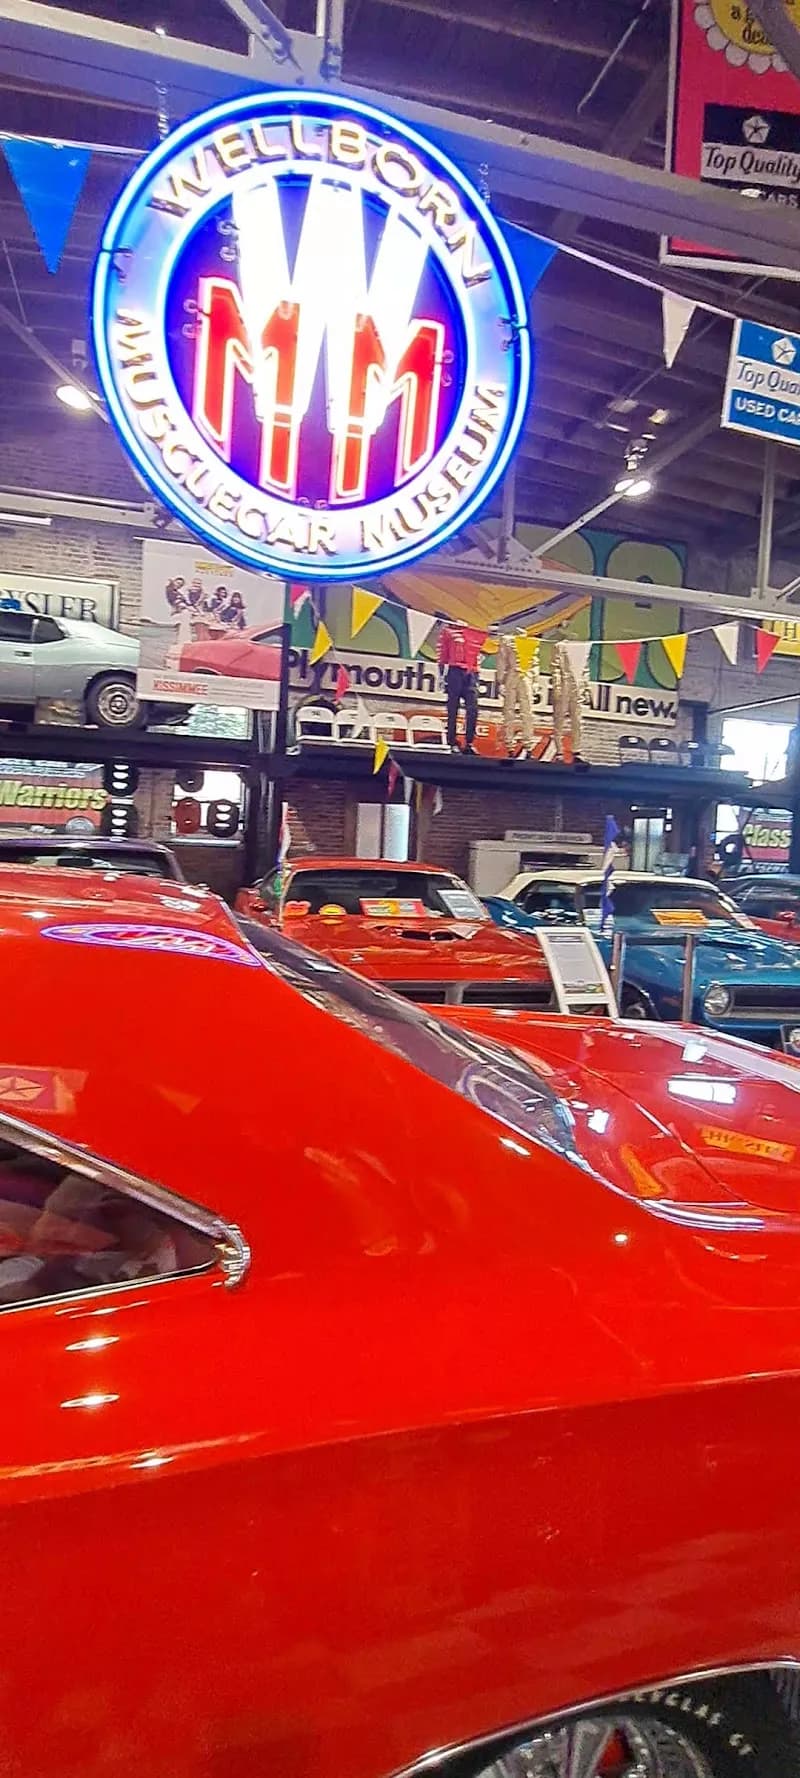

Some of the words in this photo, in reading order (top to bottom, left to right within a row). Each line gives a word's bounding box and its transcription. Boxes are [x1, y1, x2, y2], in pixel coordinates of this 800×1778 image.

[705, 145, 737, 175] Top
[740, 151, 800, 184] Quality
[149, 115, 493, 288] WELLBORN
[737, 360, 765, 389] Top
[735, 396, 776, 418] USED
[116, 308, 336, 555] MUSCLECAR
[359, 381, 508, 553] MUSEUM
[616, 695, 677, 720] new.
